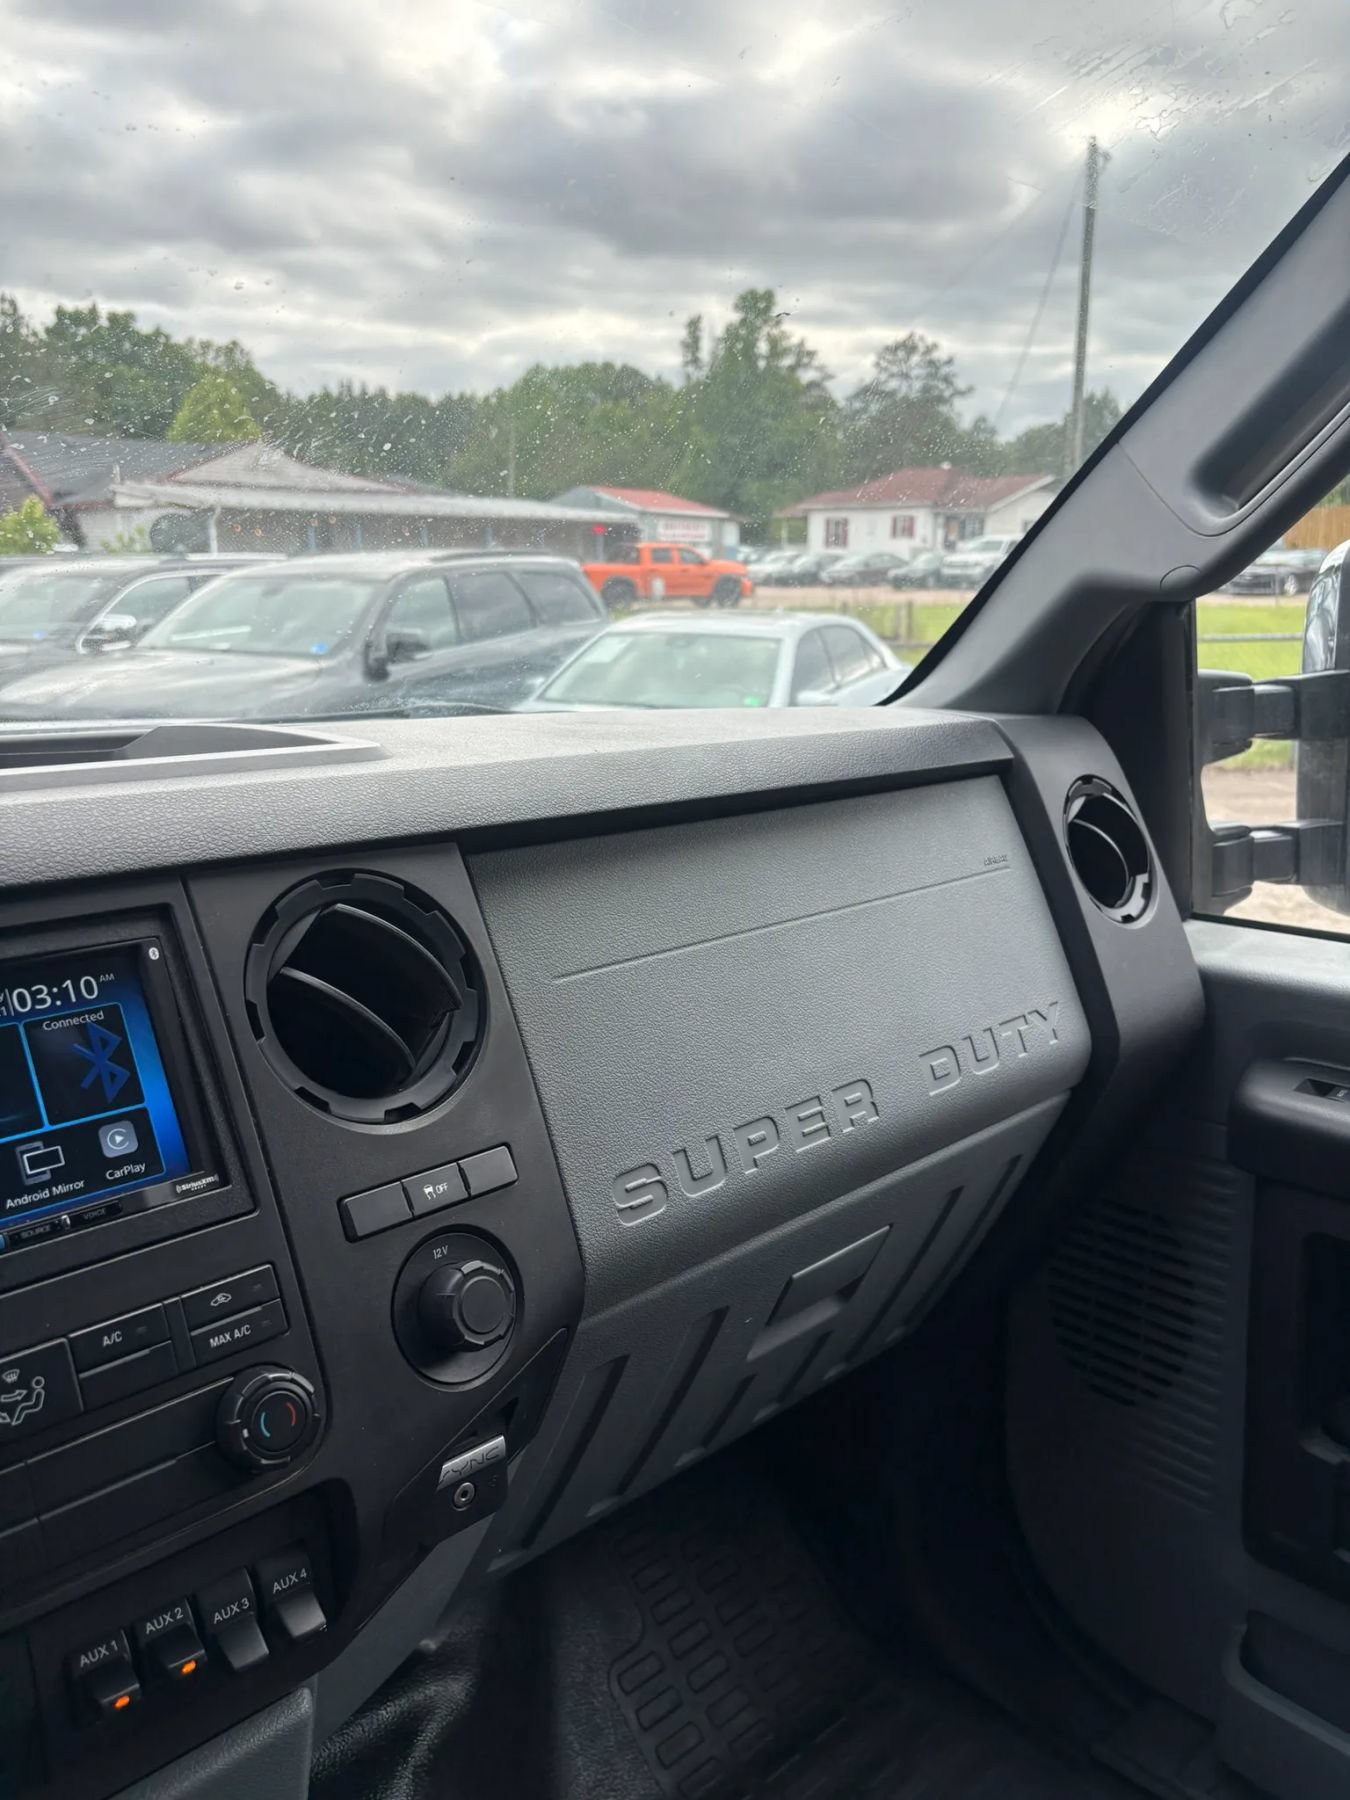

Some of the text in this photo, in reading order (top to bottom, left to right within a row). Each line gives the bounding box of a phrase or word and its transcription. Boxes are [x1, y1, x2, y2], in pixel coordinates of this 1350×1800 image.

[12, 975, 99, 1012] 03:10
[99, 973, 115, 983] AM
[42, 1010, 105, 1031] Connected
[612, 1001, 1059, 1227] SUPER DUTY
[106, 1162, 146, 1180] CarPlay
[5, 1179, 85, 1209] Android Mirror
[435, 1182, 448, 1195] OFF
[433, 1245, 448, 1260] 12V
[102, 1331, 123, 1347] A/C
[209, 1324, 251, 1348] MAX A/C
[272, 1567, 308, 1595] AUX 4
[145, 1607, 185, 1635] AUX 2
[212, 1597, 251, 1625] AUX 3
[79, 1640, 119, 1668] AUX 1
